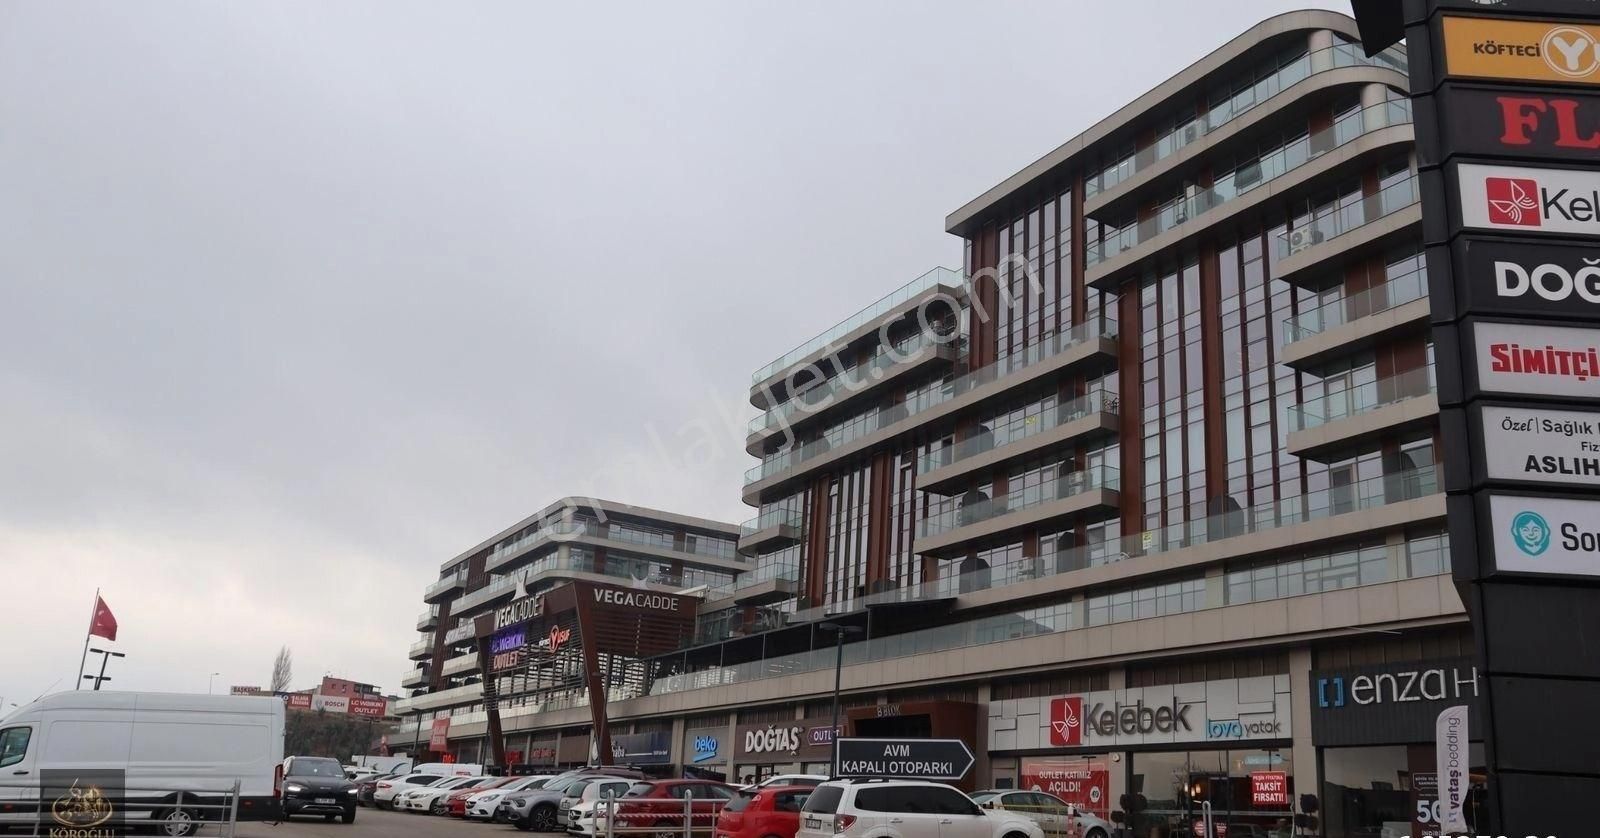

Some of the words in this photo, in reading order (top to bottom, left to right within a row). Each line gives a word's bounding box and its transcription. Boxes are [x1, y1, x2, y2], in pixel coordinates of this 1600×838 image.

[1473, 40, 1541, 57] KÖFTECİ
[1496, 96, 1600, 149] FL
[1541, 187, 1600, 223] Kel
[1494, 257, 1600, 304] DOĞ
[1502, 416, 1533, 431] Özel
[1542, 419, 1593, 436] Sağlık
[1581, 441, 1600, 452] Fiz
[1525, 455, 1600, 476] ASLIH
[594, 588, 679, 611] VEGACADDE
[495, 595, 540, 628] VEGACADDE
[493, 651, 519, 669] OUTLET
[1351, 669, 1447, 705] enza
[1083, 696, 1192, 737] Kelebek
[694, 735, 718, 753] beko
[745, 724, 800, 756] DOĞTAŞ
[813, 729, 840, 742] OUTLT
[1447, 718, 1460, 767] bedding
[883, 744, 910, 757] AVM
[842, 760, 886, 773] KAPALI
[889, 761, 953, 774] OTOPARKI
[1039, 771, 1063, 779] OUTLET
[1048, 781, 1081, 795] AÇILDI!
[1255, 780, 1281, 791] TAKSİT
